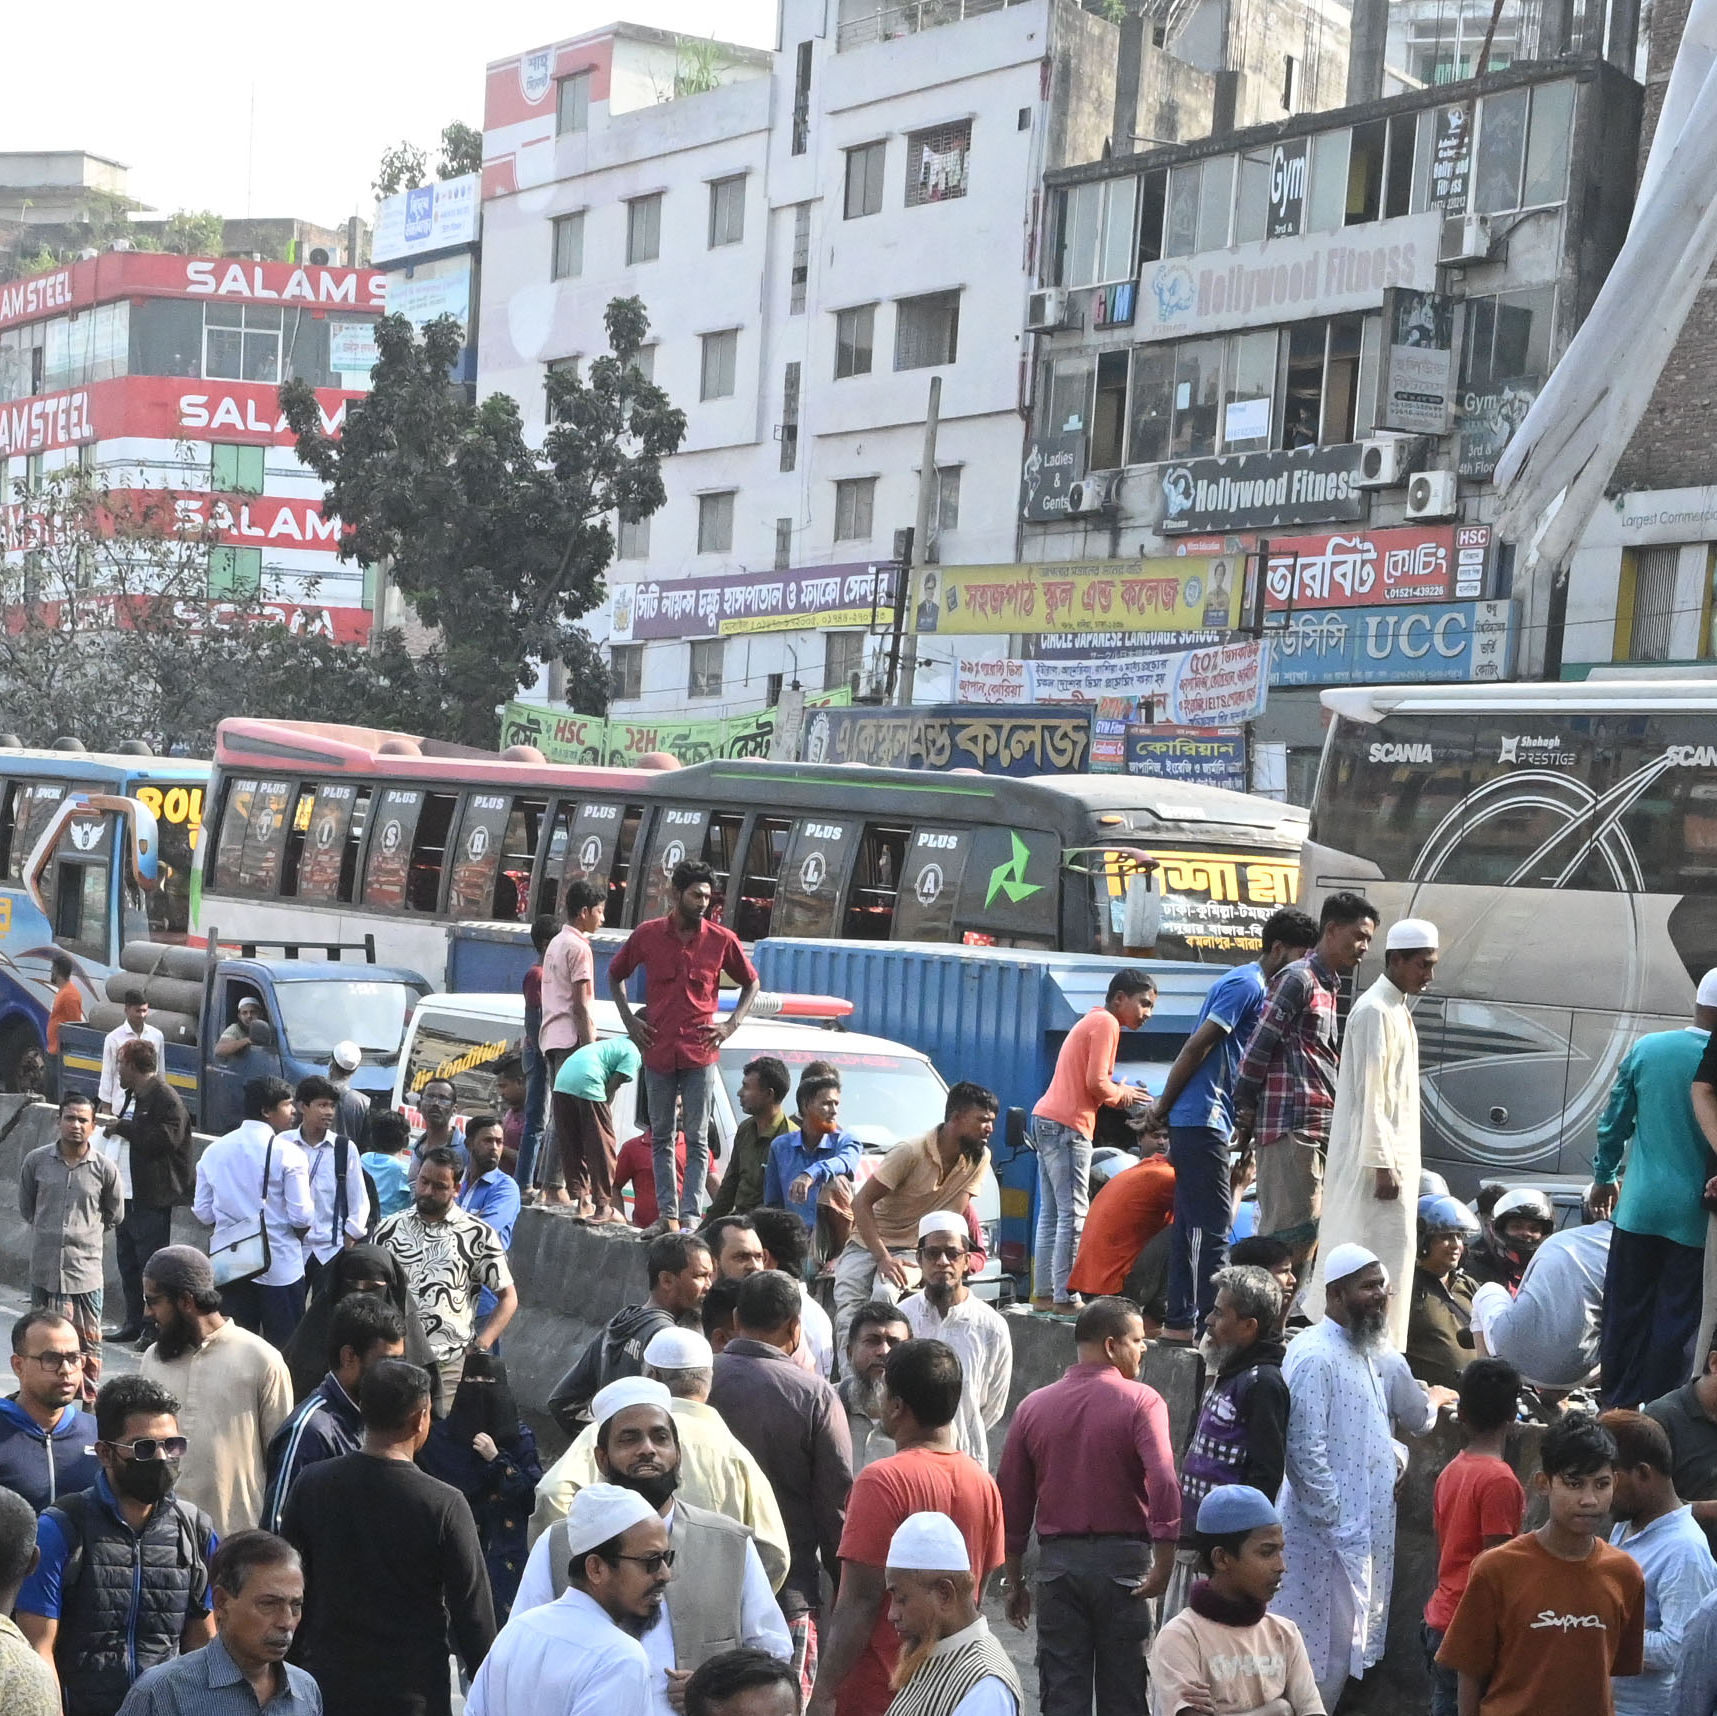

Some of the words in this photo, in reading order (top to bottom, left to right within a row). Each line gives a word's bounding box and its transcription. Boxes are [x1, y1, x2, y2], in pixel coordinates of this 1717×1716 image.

[1271, 146, 1305, 217] Gym
[186, 262, 356, 305] SALAM
[1197, 250, 1320, 317] Hollywood
[1325, 242, 1416, 297] Fitness
[27, 272, 72, 313] STEEL
[1464, 392, 1496, 415] Gym
[31, 392, 92, 448] STEEL
[1044, 452, 1073, 467] Ladies
[1054, 473, 1061, 487] &
[1195, 471, 1288, 513] Hollywood
[1291, 469, 1361, 504] Fitness
[1043, 496, 1069, 511] Gents
[173, 500, 343, 542] SALAM
[1622, 510, 1658, 529] Largest
[1459, 529, 1487, 545] HSC
[1384, 543, 1447, 584] কোচিং
[636, 583, 660, 621] সিটি
[662, 589, 696, 620] লায়ন্স
[698, 588, 721, 631] চক্ষু
[724, 582, 783, 615] হাসপাতাল
[787, 582, 796, 609] ও
[965, 567, 1038, 623] সহজপাঠ
[1042, 581, 1075, 630] স্কুল
[1121, 577, 1179, 616] কলেজ
[1041, 632, 1073, 650] CIRCLE
[1074, 632, 1122, 649] JAPANESE
[1125, 632, 1176, 646] LANGUAGE
[1179, 631, 1220, 644] SCHOOL
[1366, 613, 1467, 660] UCC
[1085, 675, 1103, 688] ভিসা
[554, 718, 588, 746] HSC
[1520, 735, 1561, 749] Shohagh
[953, 719, 1088, 772] কলেজ
[1137, 737, 1234, 757] কোরিয়ান
[1368, 742, 1433, 764] SCANIA
[1517, 752, 1577, 766] PRESTIGE
[261, 782, 288, 794] PLUS
[323, 786, 351, 799] PLUS
[387, 791, 417, 804] PLUS
[474, 796, 504, 810] PLUS
[584, 805, 617, 819] PLUS
[666, 811, 701, 825] PLUS
[805, 824, 843, 840] PLUS
[918, 833, 958, 850] PLUS
[410, 1068, 435, 1092] Air
[435, 1039, 507, 1079] Condition
[1530, 1610, 1607, 1634] Supra
